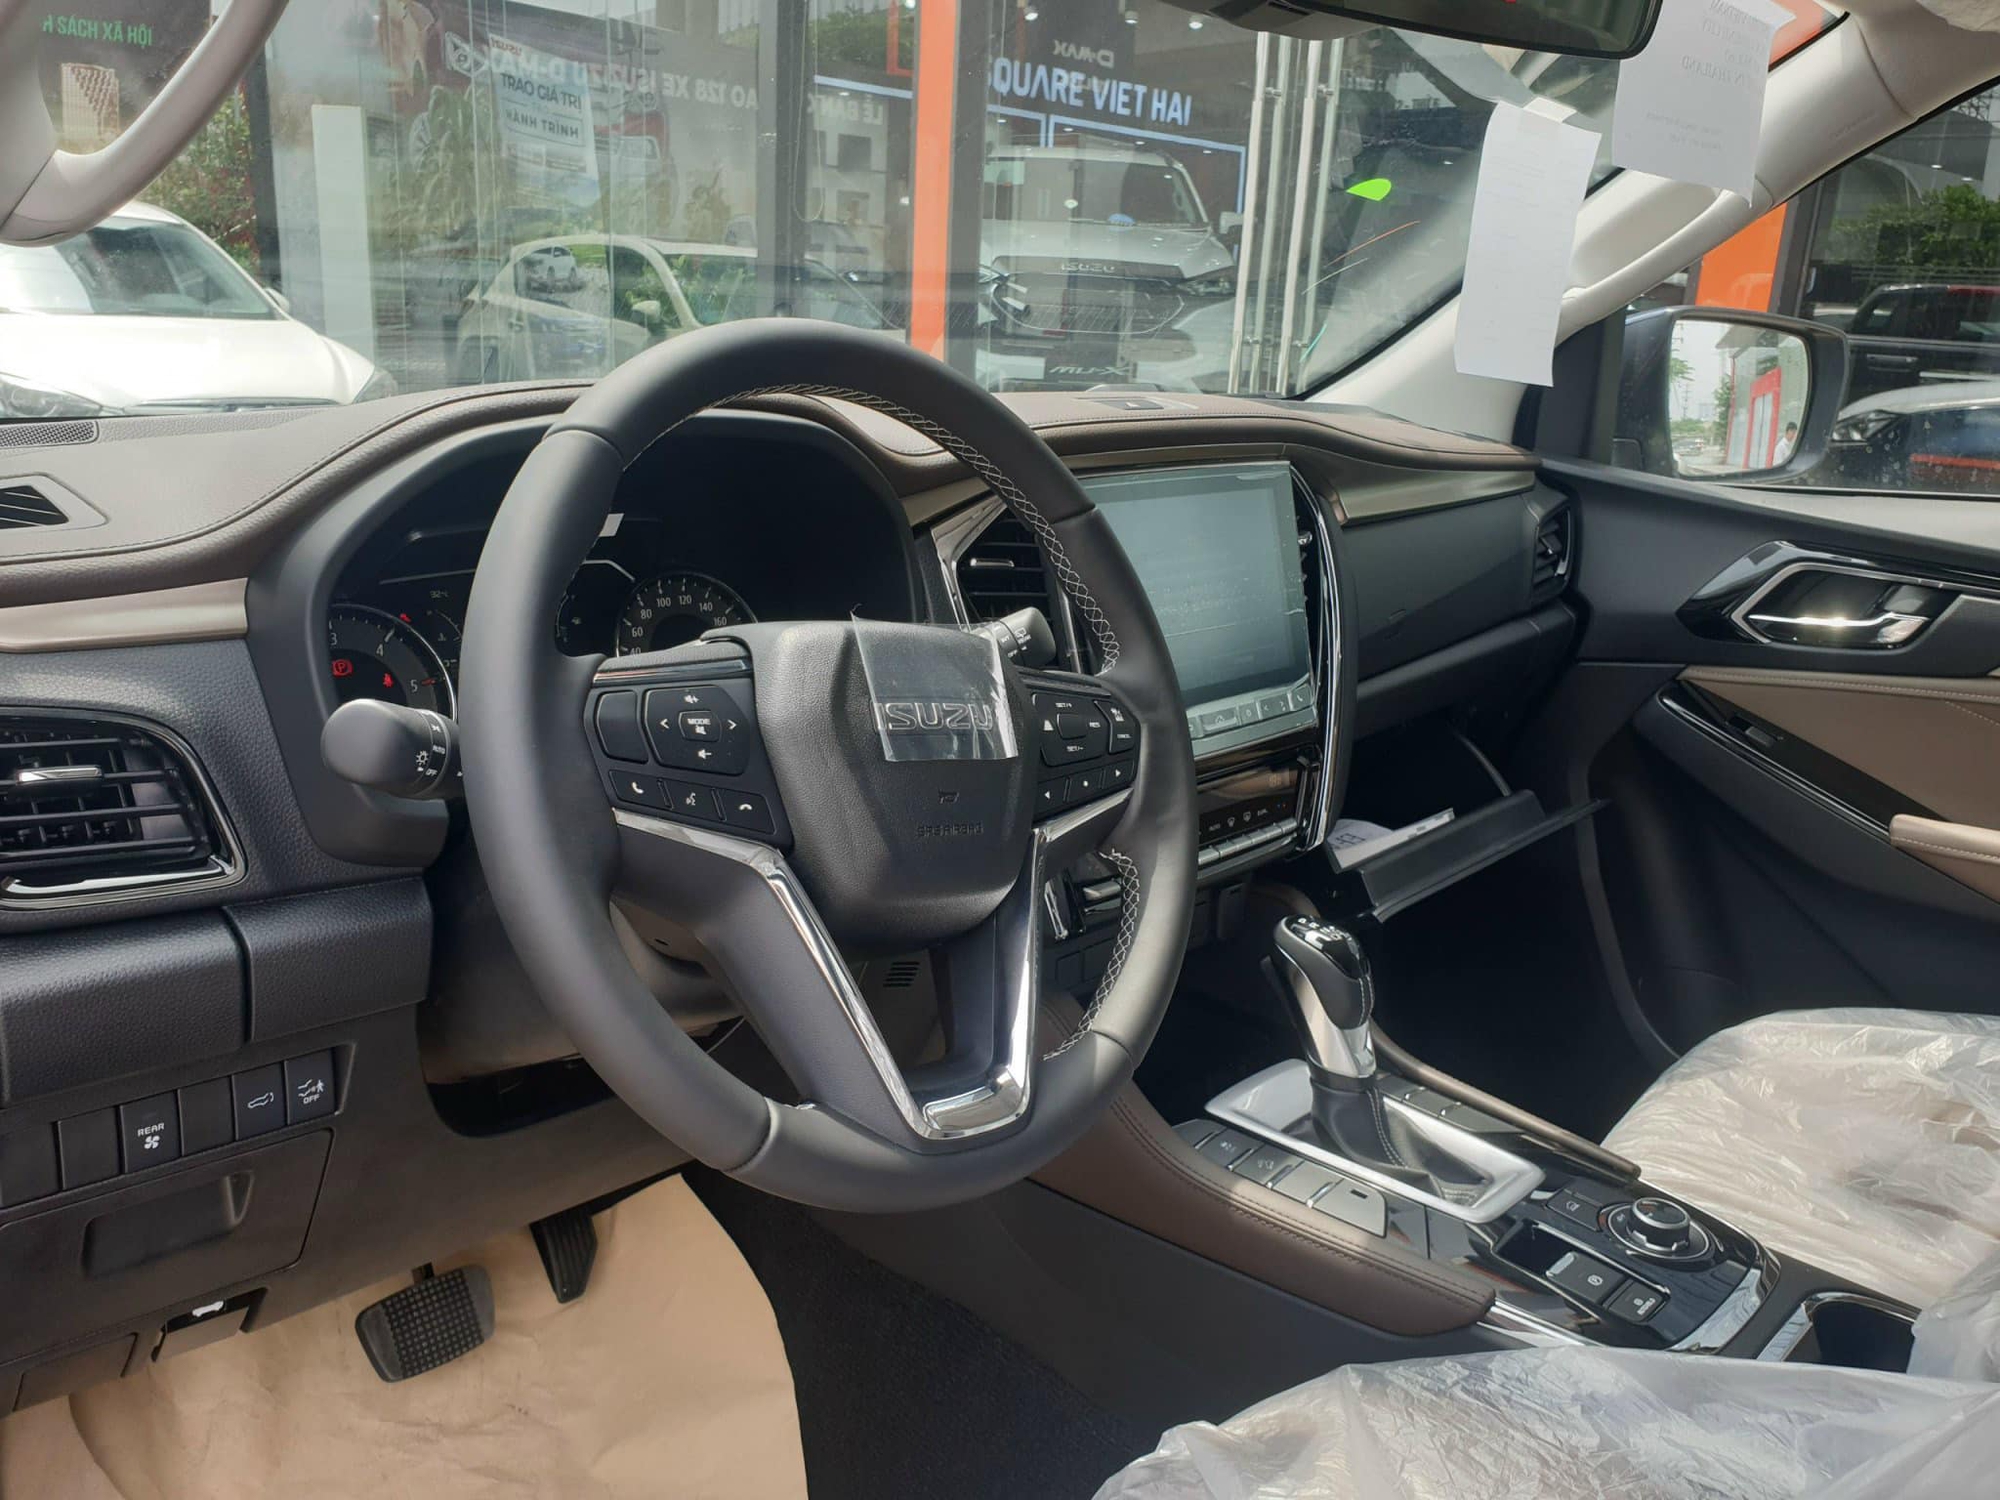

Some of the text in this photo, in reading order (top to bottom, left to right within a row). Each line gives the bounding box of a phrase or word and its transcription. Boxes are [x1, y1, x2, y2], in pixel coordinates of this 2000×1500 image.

[57, 14, 98, 39] SÁCH
[103, 20, 123, 42] XÃ
[127, 23, 152, 49] HỘI
[500, 72, 534, 98] TRAO
[988, 57, 1192, 126] QUARE VIET HAI
[656, 597, 671, 608] 100
[680, 594, 692, 604] 120
[699, 602, 713, 612] 140
[640, 608, 652, 620] 80
[713, 616, 727, 627] 160
[632, 627, 643, 637] 60
[376, 643, 384, 657] 4
[410, 679, 418, 693] 5
[303, 1093, 320, 1105] OFF
[137, 1122, 165, 1137] REAR
